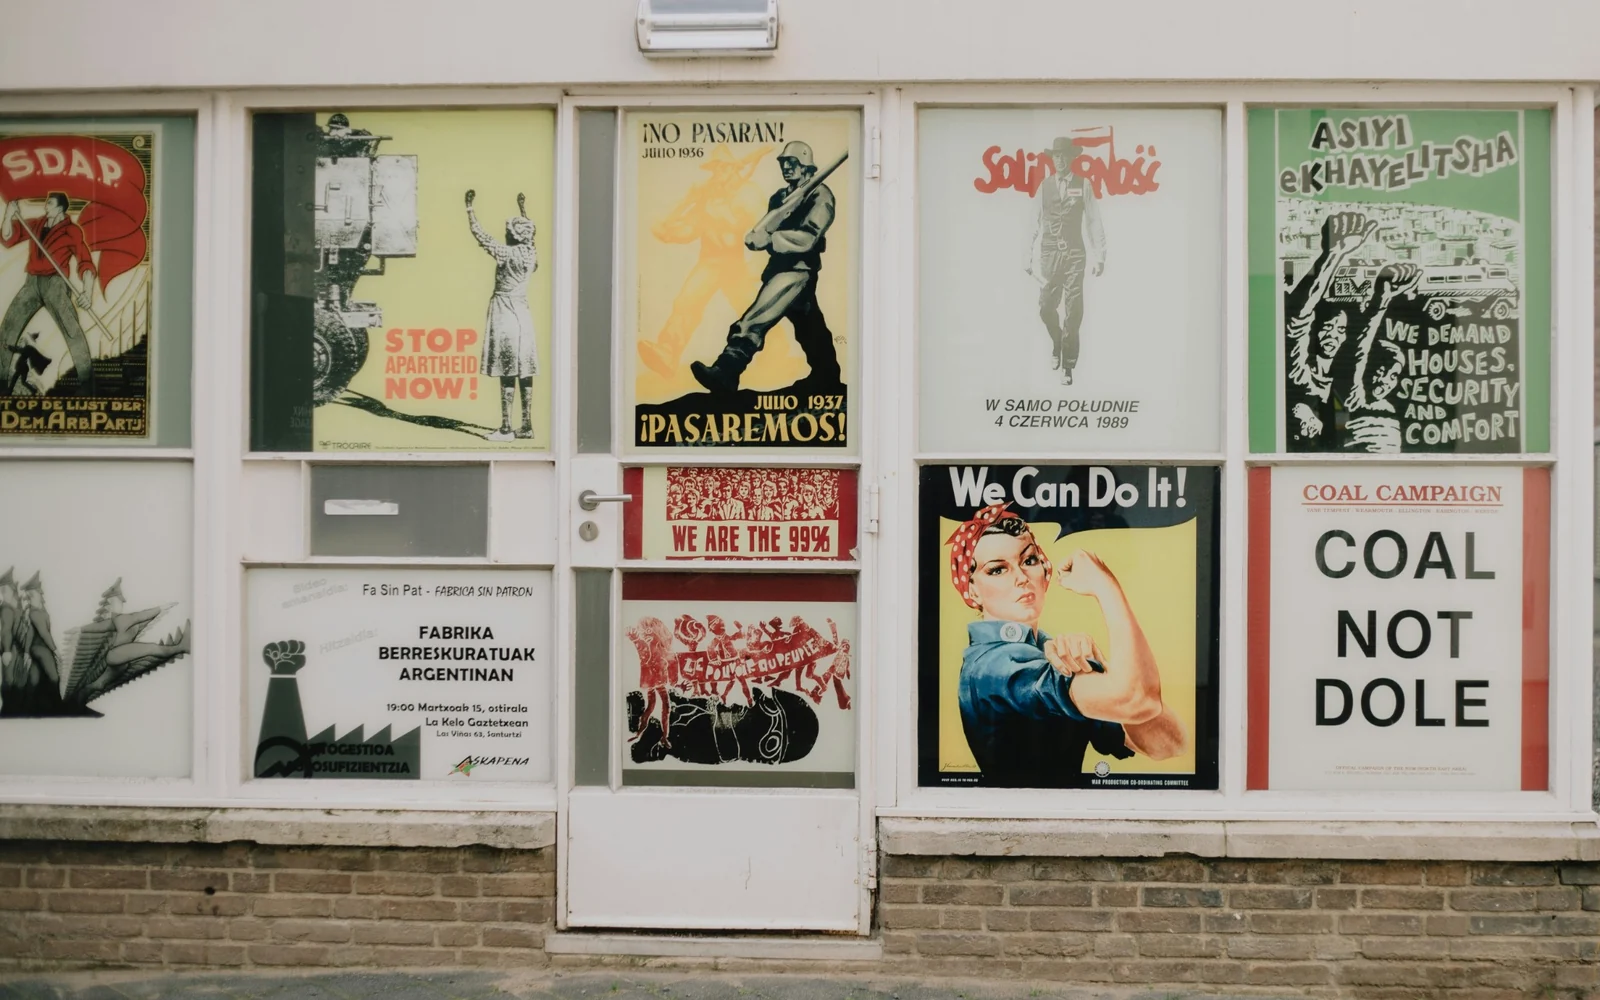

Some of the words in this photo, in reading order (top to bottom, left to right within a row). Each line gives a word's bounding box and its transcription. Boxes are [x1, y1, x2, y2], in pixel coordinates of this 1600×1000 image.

[643, 122, 681, 144] ¡NO
[1311, 117, 1408, 150] ASIYI
[679, 147, 704, 159] 1936
[2, 147, 122, 188] S.D.A.P.
[385, 328, 478, 353] STOP
[1385, 317, 1419, 345] WE
[1428, 323, 1511, 346] DEMAND
[385, 355, 478, 374] APARTHEID
[385, 377, 478, 400] NOW!
[1397, 376, 1520, 408] SECURITY
[16, 400, 38, 411] OP
[42, 400, 63, 411] DE
[66, 400, 108, 411] LIJST
[111, 401, 141, 411] DER
[754, 395, 798, 410] JULIO
[808, 395, 844, 410] 1937
[985, 399, 1000, 412] W
[1004, 399, 1052, 412] SAMO
[1057, 400, 1139, 413] POŁUDNIE
[1405, 403, 1447, 421] AND
[640, 412, 846, 443] ¡PASAREMOS!
[994, 415, 1003, 428] 4
[1009, 415, 1089, 428] CZERWCA
[1096, 415, 1129, 429] 1989
[1406, 410, 1519, 445] COMFORT
[950, 467, 1005, 508] We
[1013, 467, 1080, 508] Can
[1088, 467, 1139, 508] Do
[1148, 467, 1188, 508] It!
[1303, 485, 1369, 501] COAL
[1376, 485, 1503, 502] CAMPAIGN
[672, 525, 698, 552] WE
[705, 525, 739, 552] ARE
[747, 525, 781, 552] THE
[788, 525, 830, 553] 99%
[1315, 529, 1496, 579] COAL
[362, 583, 377, 596] Fa
[380, 583, 399, 596] Sin
[403, 584, 422, 596] Pat
[435, 585, 475, 597] FABRICA
[477, 586, 494, 597] SIN
[496, 586, 533, 597] PATRON
[419, 626, 494, 640] FABRIKA
[1337, 609, 1473, 659] NOT
[379, 647, 535, 661] BERRESKURATUAK
[399, 668, 514, 682] ARGENTINAN
[386, 703, 415, 712] 19:00
[418, 703, 469, 712] Martxoak
[472, 704, 485, 714] 15,
[488, 704, 528, 713] ostirala
[1315, 677, 1490, 727] DOLE
[425, 717, 438, 727] La
[442, 717, 465, 727] Kelo
[467, 718, 529, 727] Gaztetxean
[456, 755, 530, 769] ASKAPENA
